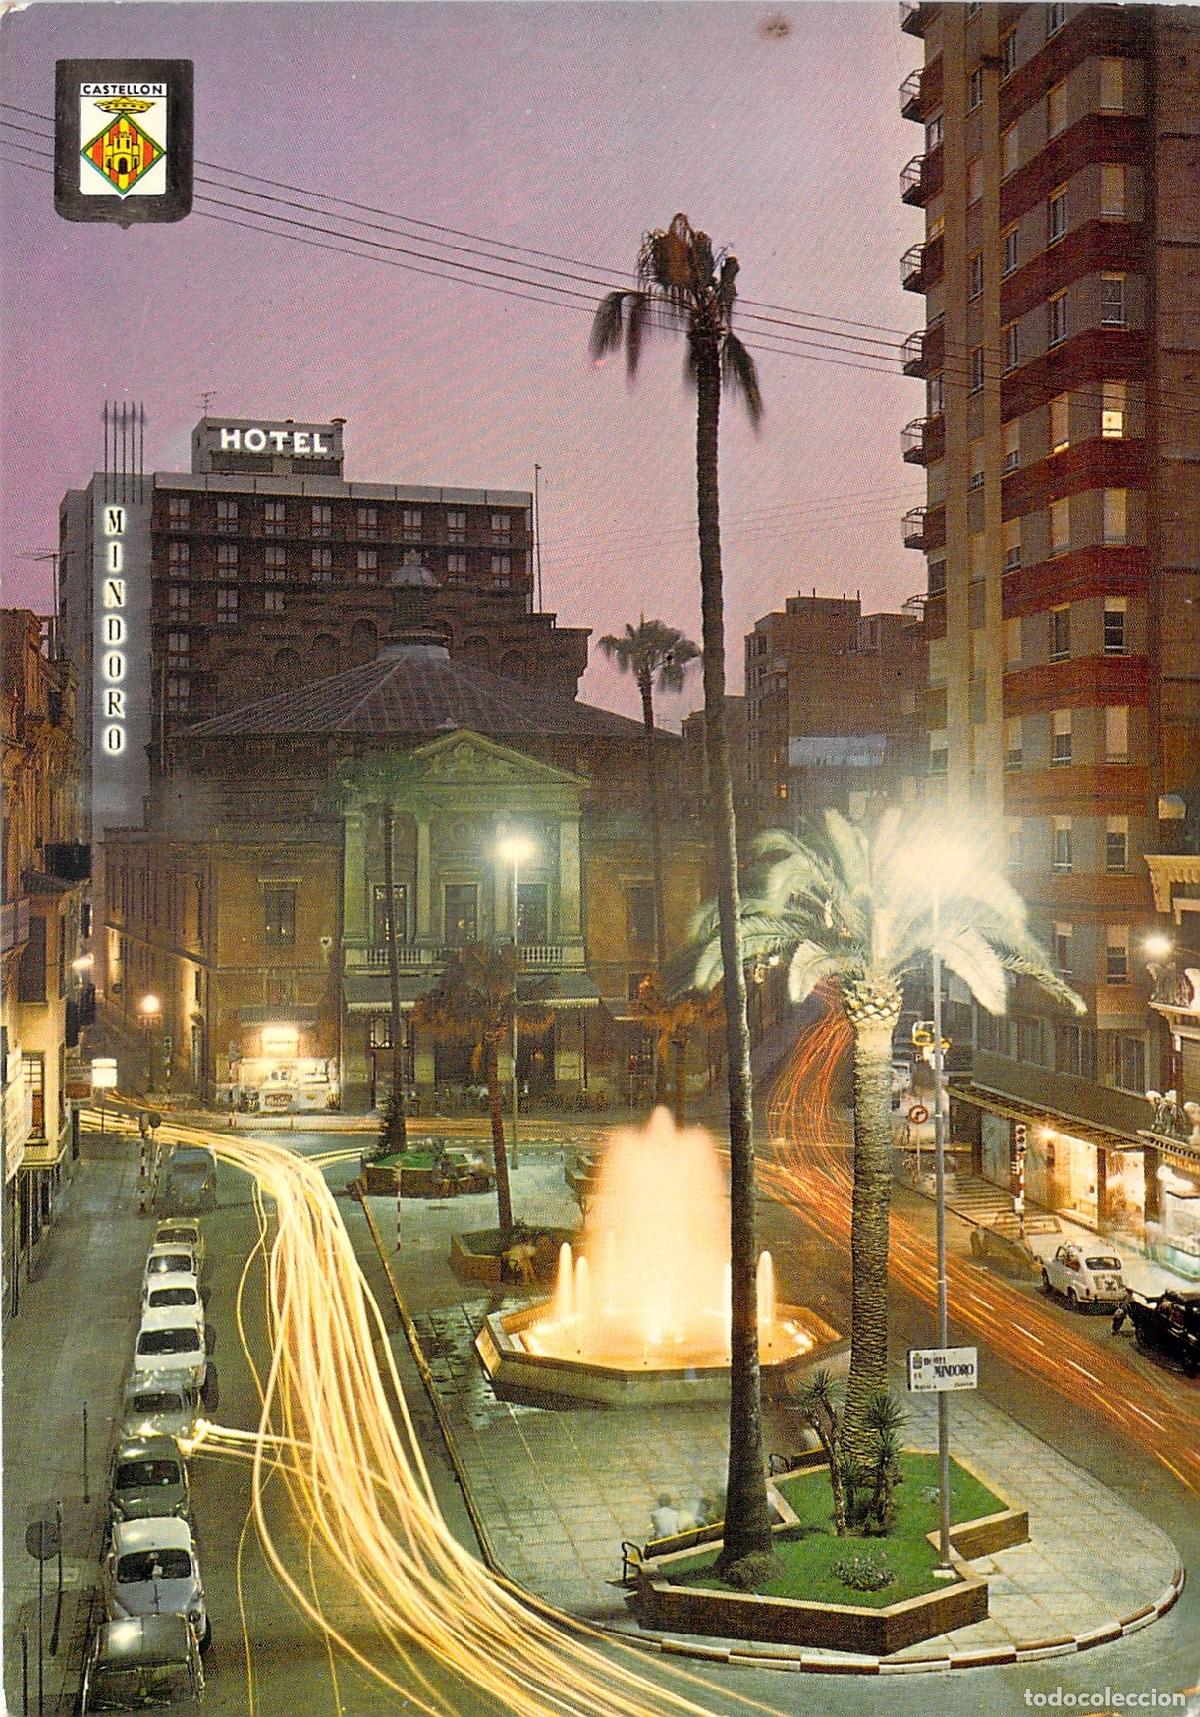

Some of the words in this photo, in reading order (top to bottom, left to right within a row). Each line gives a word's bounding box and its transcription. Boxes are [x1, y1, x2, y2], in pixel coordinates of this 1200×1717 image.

[220, 428, 328, 453] HOTEL
[104, 506, 126, 755] MINDORO
[934, 1363, 974, 1378] MINDORO
